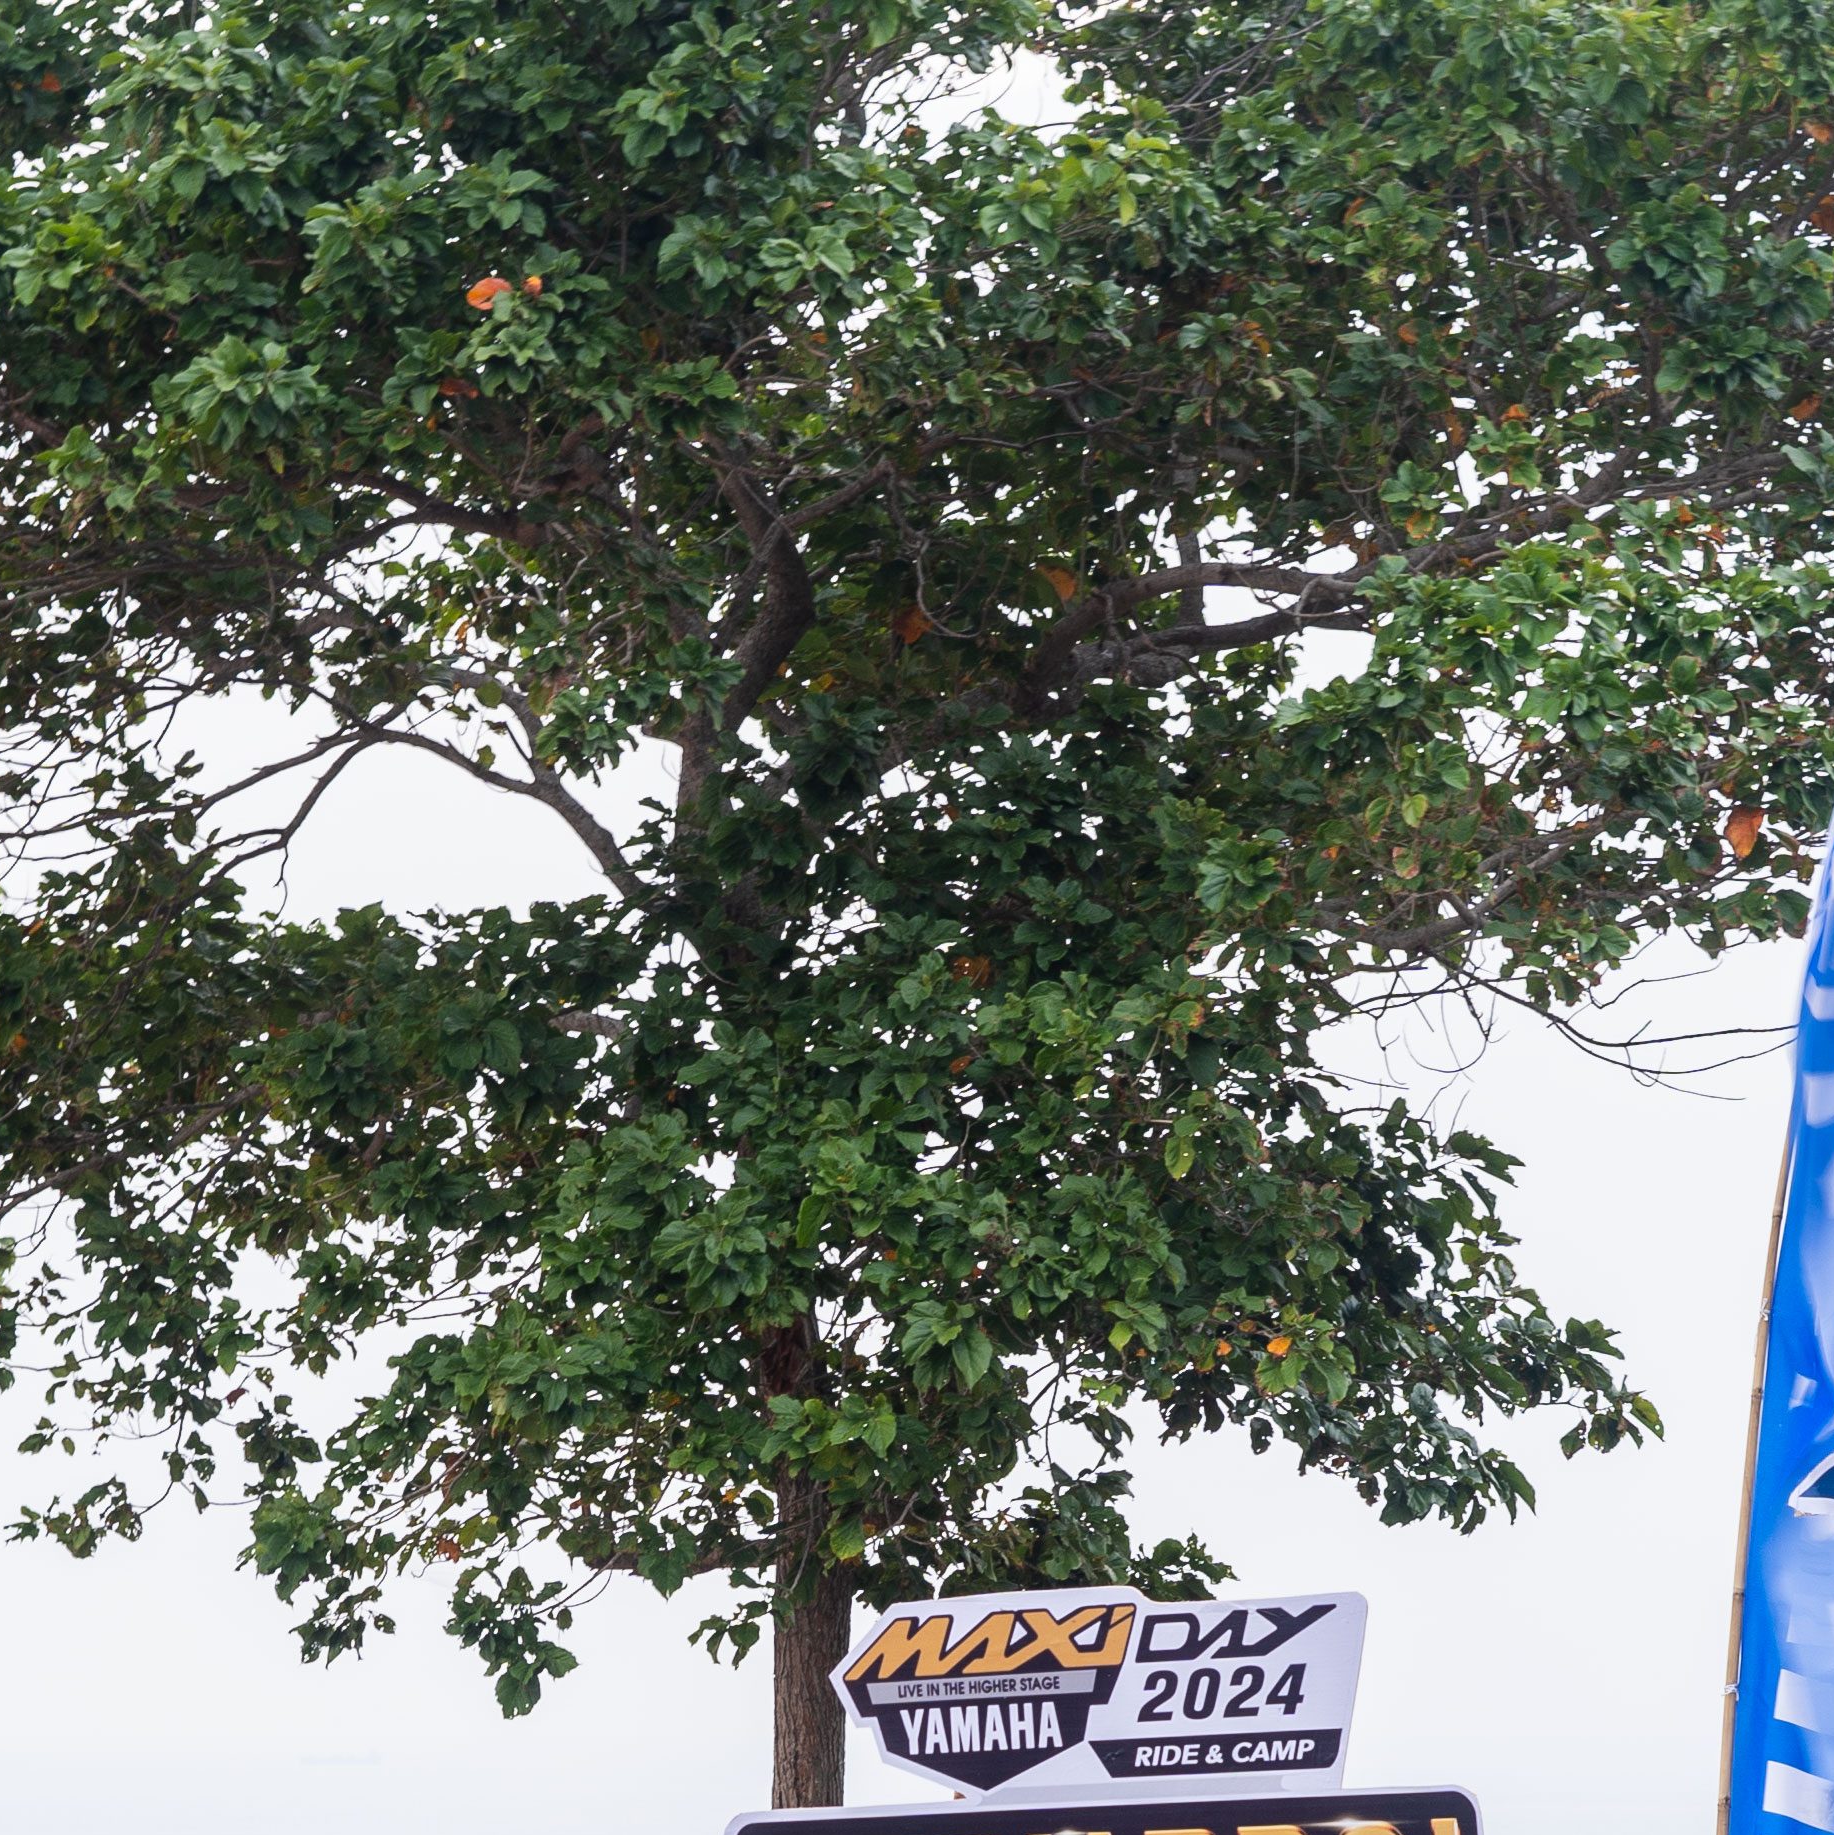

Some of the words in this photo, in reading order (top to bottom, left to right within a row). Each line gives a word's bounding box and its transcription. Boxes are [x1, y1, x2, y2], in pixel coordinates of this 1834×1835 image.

[1135, 1604, 1337, 1663] DAY
[897, 1683, 923, 1698] LIVE
[926, 1682, 938, 1697] IN
[941, 1681, 966, 1697] THE
[968, 1678, 1017, 1695] HIGHER
[1019, 1675, 1061, 1692] STAGE
[1137, 1663, 1307, 1723] 2024
[899, 1701, 1063, 1755] YAMAHA
[1134, 1743, 1201, 1767] RIDE
[1205, 1743, 1223, 1764] &
[1231, 1738, 1315, 1763] CAMP
